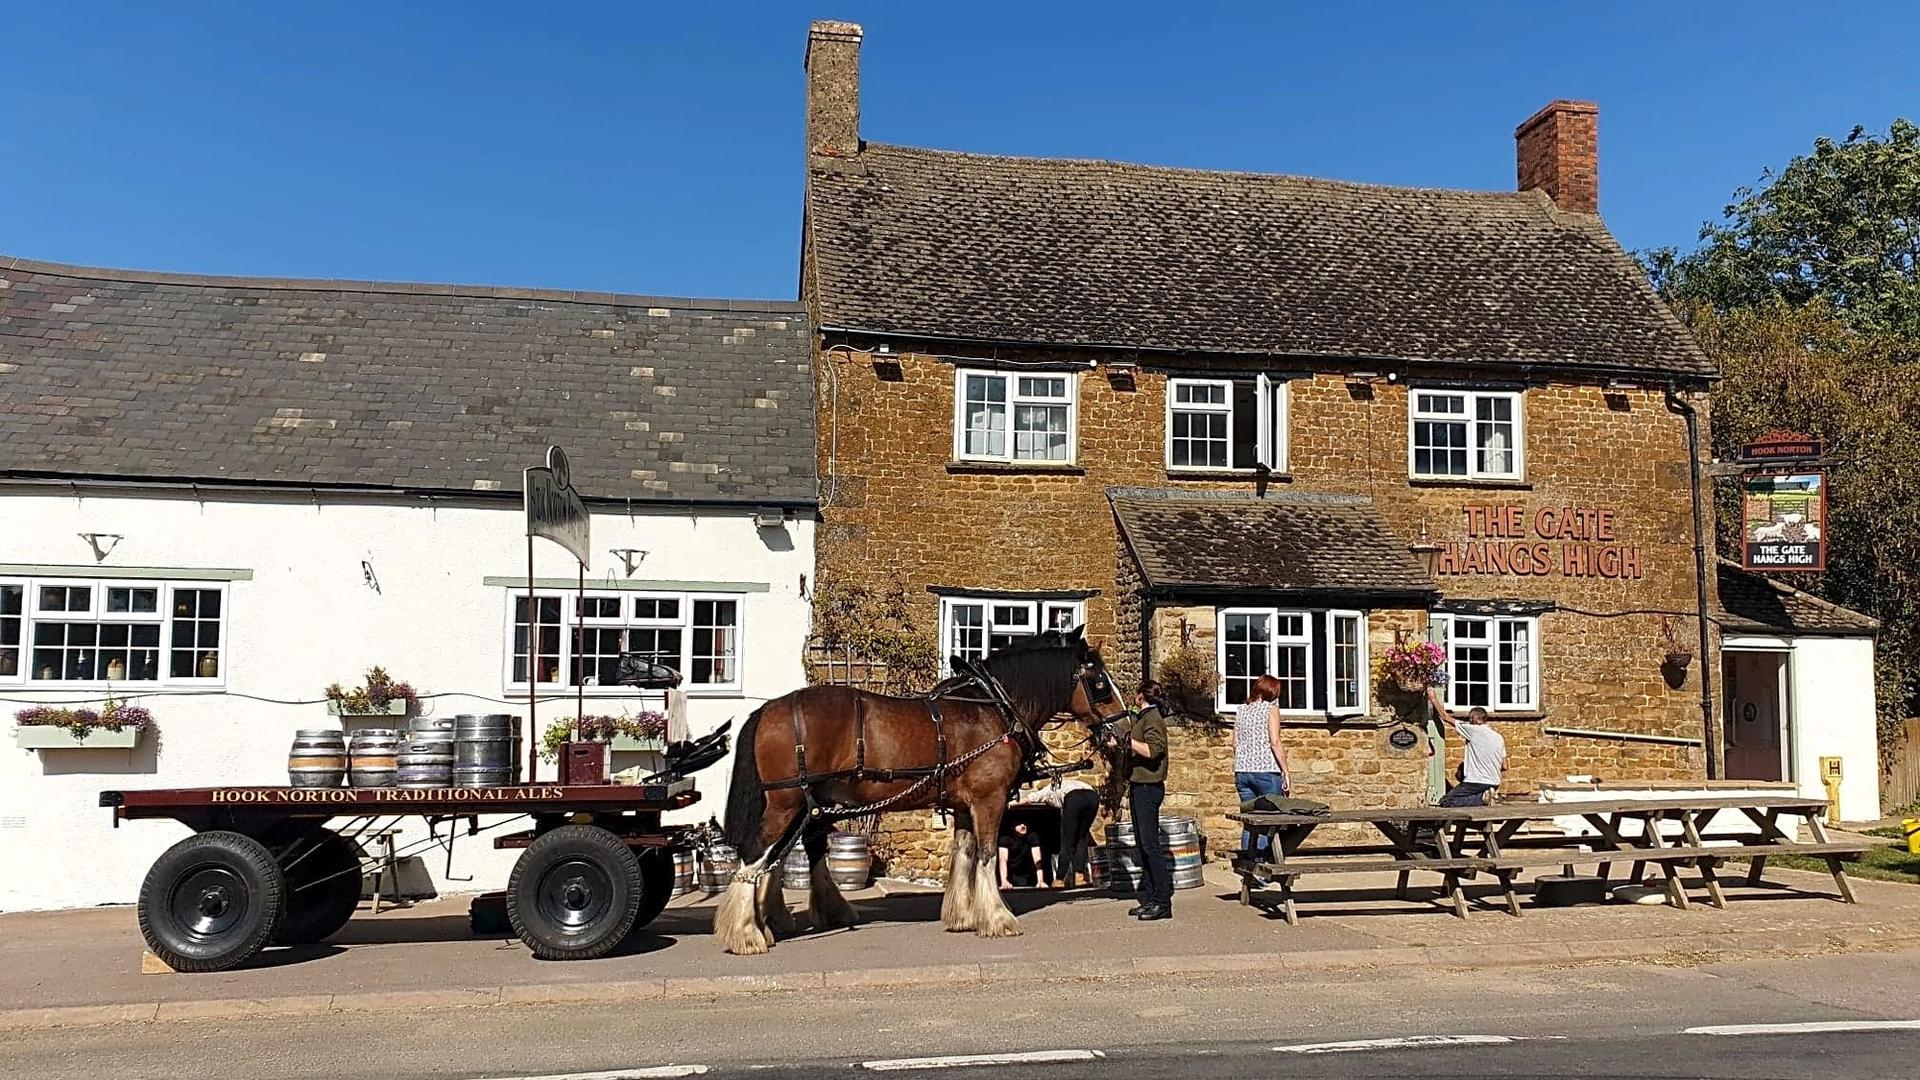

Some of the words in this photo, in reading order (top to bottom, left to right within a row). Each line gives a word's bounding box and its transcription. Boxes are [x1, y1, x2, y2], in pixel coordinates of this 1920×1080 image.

[1751, 447, 1776, 456] HOOK
[1777, 445, 1813, 454] NORTON
[1463, 504, 1525, 538] THE
[1534, 506, 1615, 542] GATE
[1760, 545, 1779, 555] THE
[1781, 545, 1806, 555] GATE
[1438, 542, 1551, 576] HANGS
[1562, 543, 1642, 579] HIGH
[1753, 554, 1786, 564] HANGS
[1788, 554, 1813, 564] HIGH
[1829, 760, 1841, 775] H
[211, 790, 269, 802] HOOK
[275, 789, 358, 802] NORTON
[372, 788, 509, 801] TRADITIONAL
[515, 787, 564, 800] ALES
